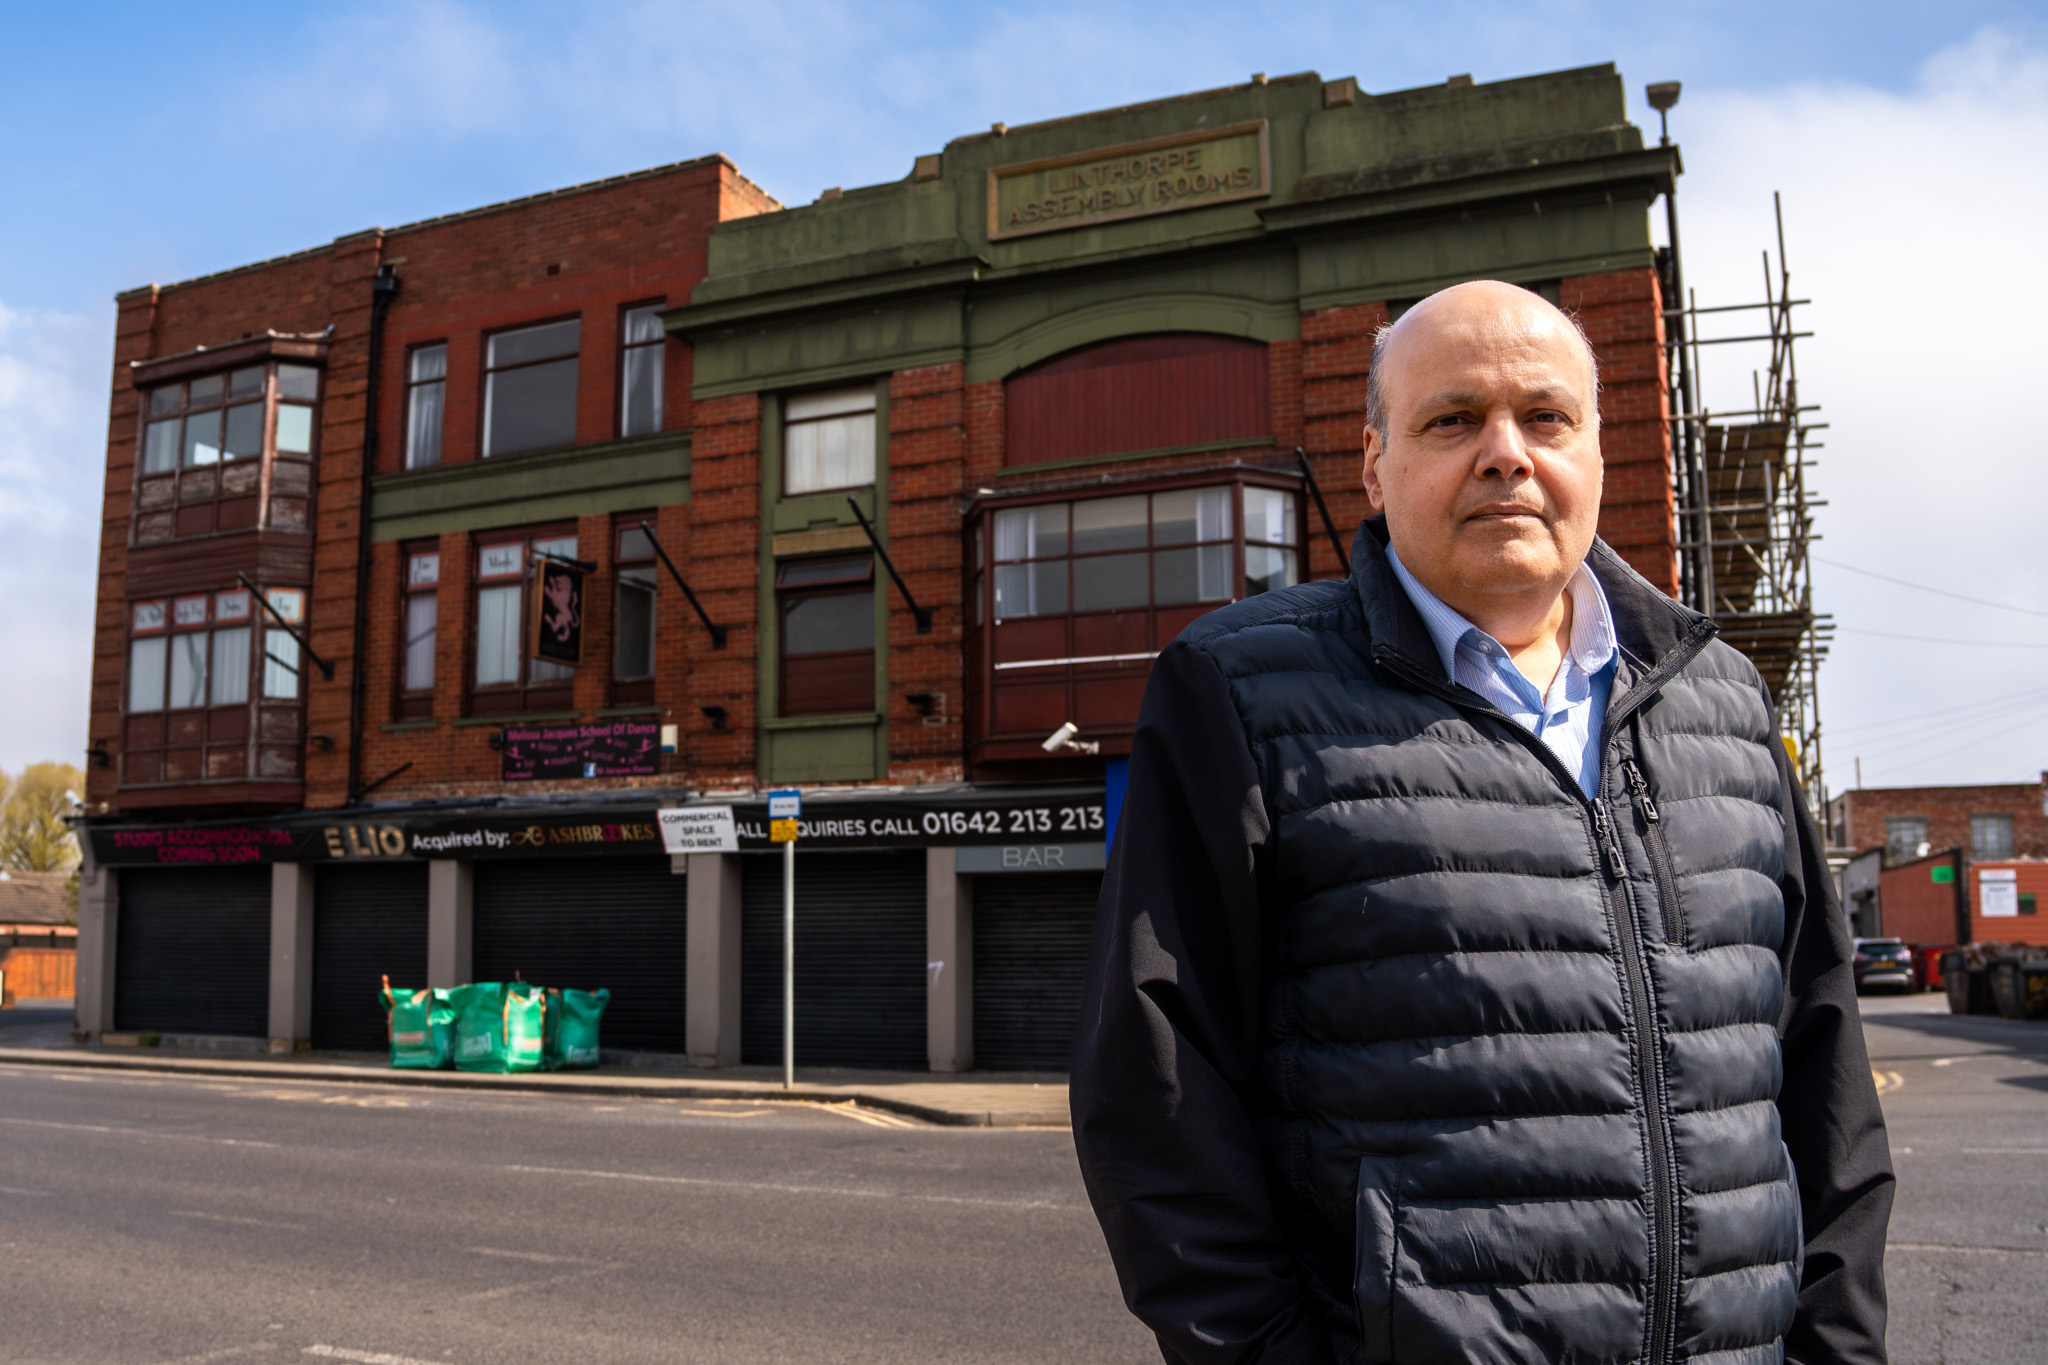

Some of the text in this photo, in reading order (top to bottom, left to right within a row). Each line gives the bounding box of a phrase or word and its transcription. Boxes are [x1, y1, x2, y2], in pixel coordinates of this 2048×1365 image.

[1050, 149, 1202, 195] LINTHORPE
[1008, 166, 1252, 226] ASSEMBLY ROOMS
[507, 723, 657, 741] Melissa Jacques School Of Dance
[662, 811, 729, 824] COMMERCIAL
[736, 822, 768, 838] ALL
[797, 819, 867, 838] QUIRIES
[870, 818, 920, 836] CALL
[922, 811, 1002, 835] 01642
[1008, 809, 1052, 832] 213
[1060, 806, 1105, 831] 213
[113, 827, 293, 847] STUDIO ACCOMMODATON
[413, 829, 511, 851] Acquired by:
[682, 825, 715, 835] SPACE
[680, 838, 723, 847] TO RENT
[157, 845, 260, 863] COMING SOON
[1001, 846, 1065, 868] BAR
